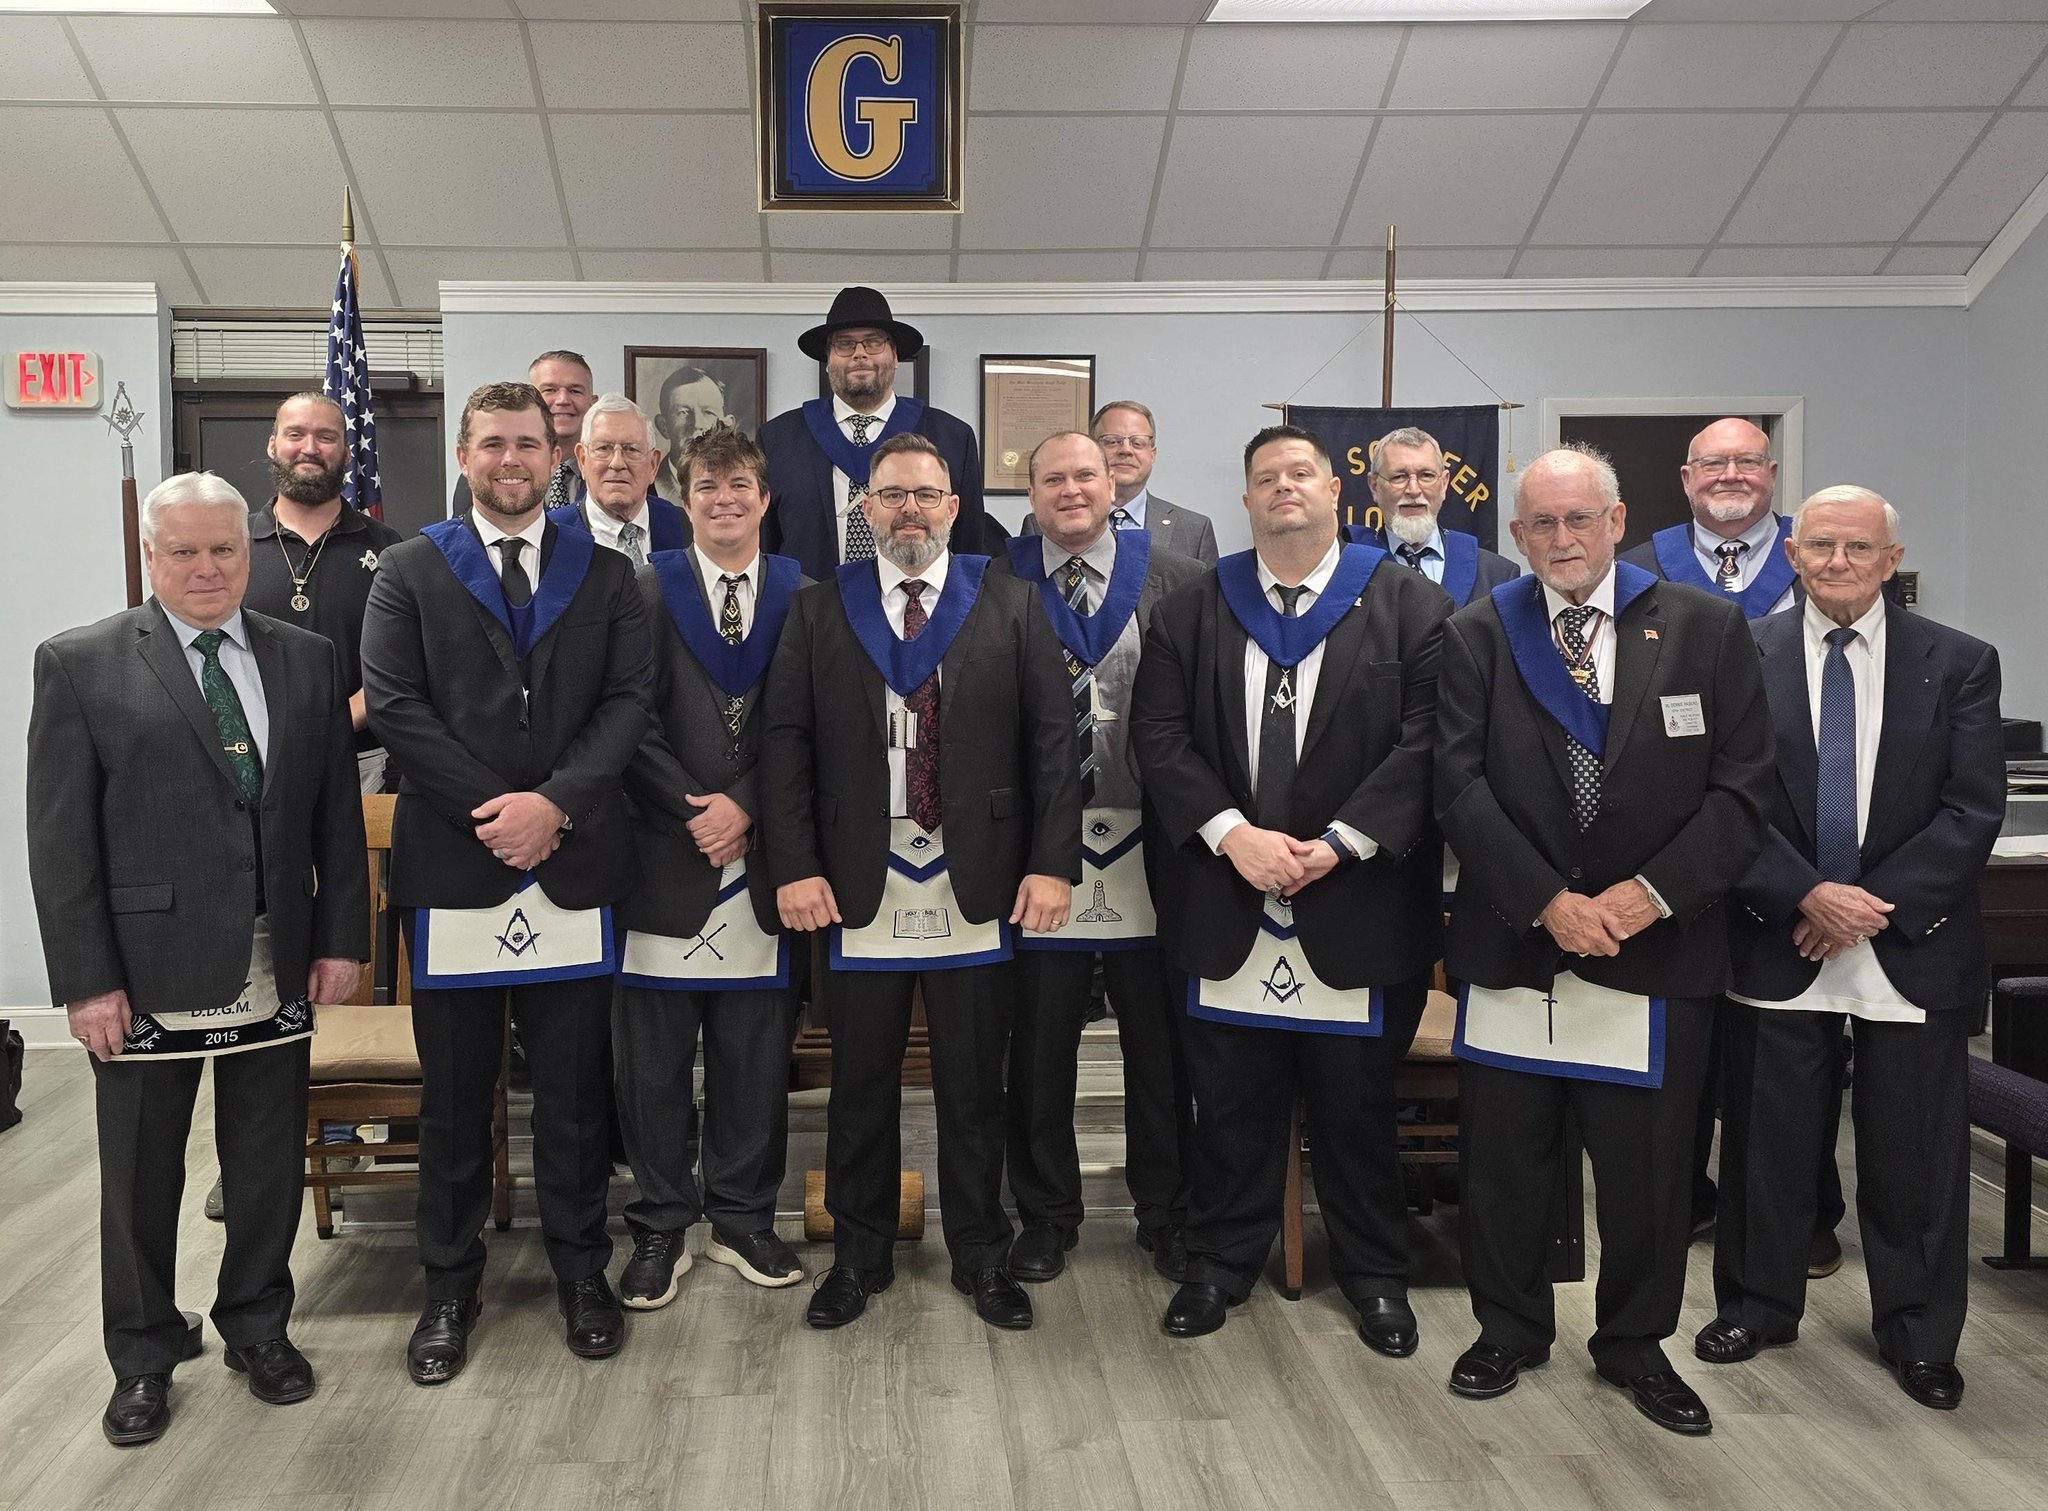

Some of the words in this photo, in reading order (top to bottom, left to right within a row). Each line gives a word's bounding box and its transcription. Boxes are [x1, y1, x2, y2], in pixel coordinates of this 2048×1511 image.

[805, 33, 918, 182] G
[19, 353, 86, 404] EXIT
[191, 1001, 252, 1017] D.D.G.M.
[205, 1030, 239, 1045] 2015
